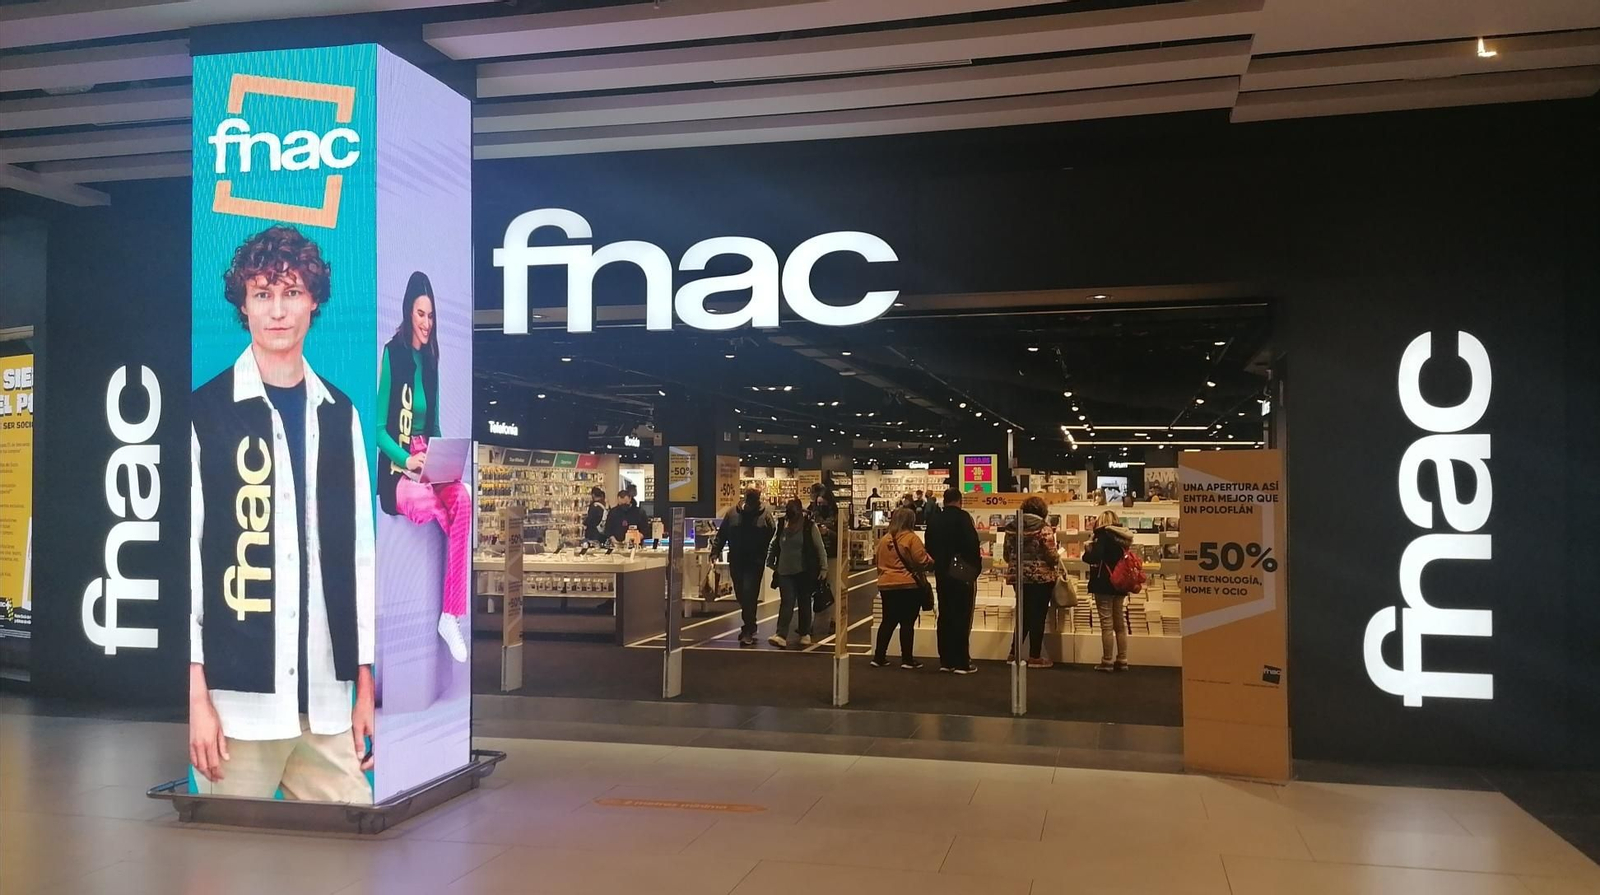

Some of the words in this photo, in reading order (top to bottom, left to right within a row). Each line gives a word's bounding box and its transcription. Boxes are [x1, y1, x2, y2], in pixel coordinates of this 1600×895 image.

[208, 117, 361, 174] fnac
[492, 207, 900, 335] fnac
[671, 467, 694, 476] -50%
[1183, 483, 1204, 491] UNA
[1206, 482, 1259, 491] APERTURA
[1262, 480, 1279, 491] ASÍ
[981, 496, 1007, 506] -50%
[1183, 494, 1216, 503] ENTRA
[1217, 494, 1254, 503] MEJOR
[1256, 494, 1279, 503] QUE
[81, 364, 162, 655] fnac
[1183, 506, 1198, 514] UN
[1200, 504, 1254, 514] POLOFLÁN
[1363, 330, 1494, 708] fnac
[223, 435, 273, 621] fnac
[1184, 542, 1278, 573] -50%
[1198, 574, 1263, 586] TECNOLOGÍA,
[1184, 586, 1211, 594] HOME
[1214, 586, 1220, 594] Y
[1222, 587, 1248, 596] OCIO
